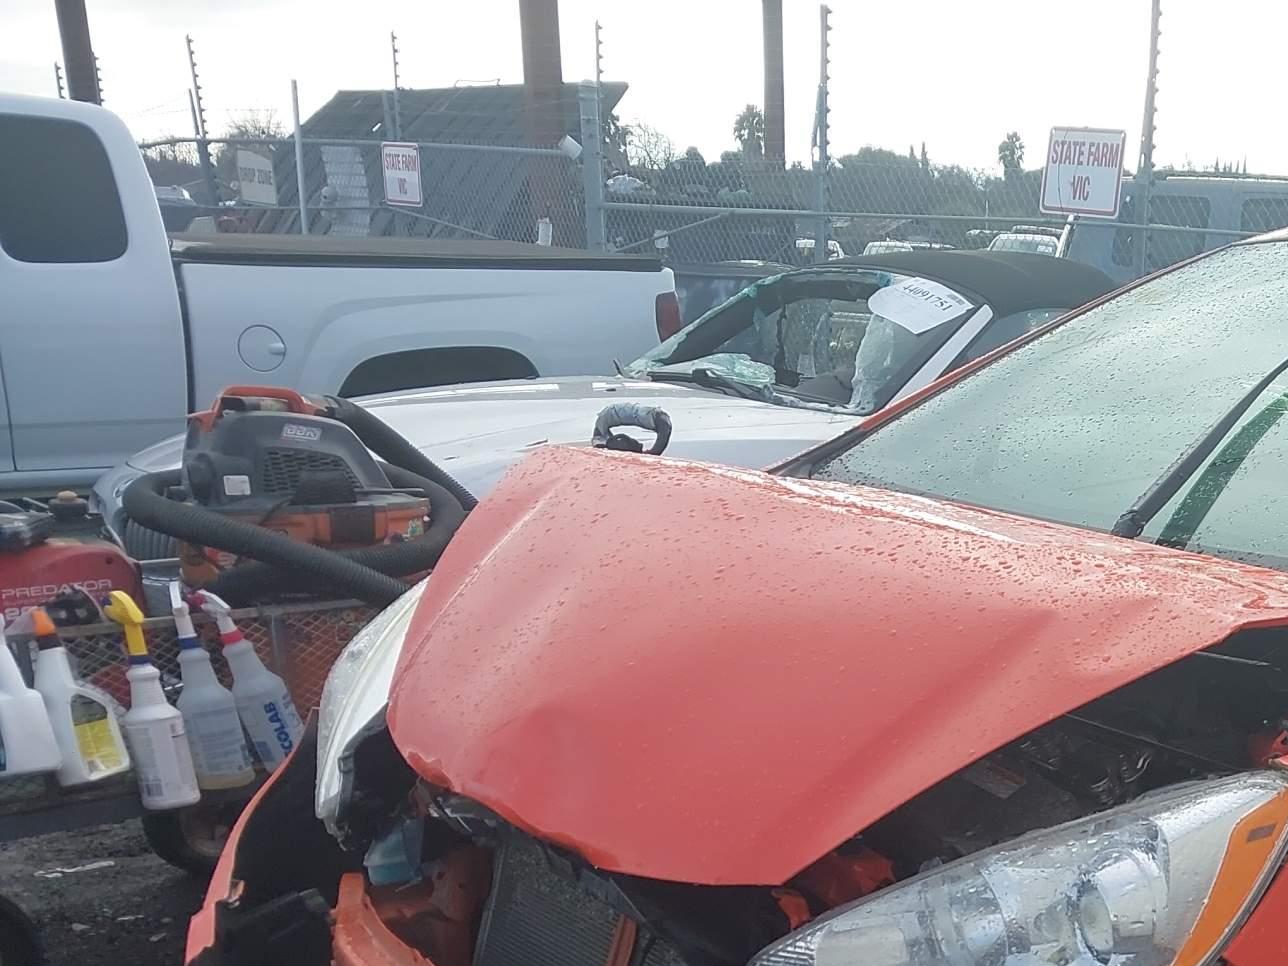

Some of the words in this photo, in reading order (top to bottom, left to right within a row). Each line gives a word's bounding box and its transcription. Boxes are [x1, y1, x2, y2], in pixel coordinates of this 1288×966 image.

[385, 153, 401, 171] STATE
[401, 153, 417, 172] FARM
[1052, 140, 1085, 166] STATE
[1087, 142, 1119, 168] FARM
[1072, 175, 1090, 201] VIC
